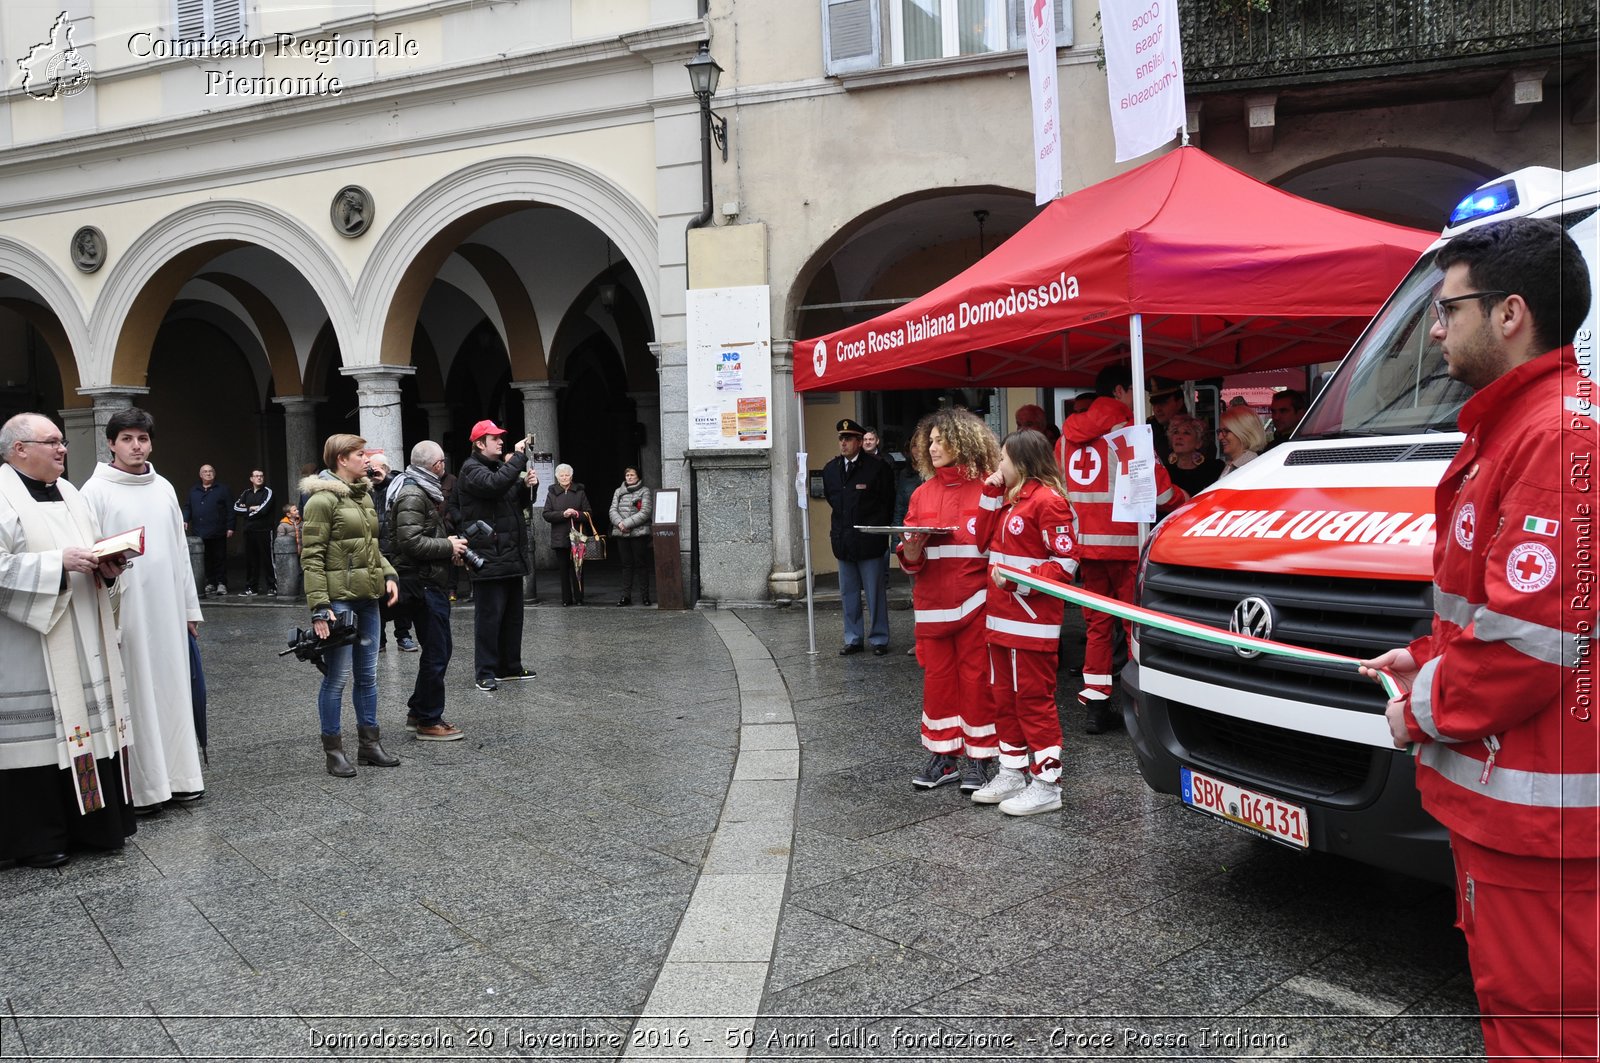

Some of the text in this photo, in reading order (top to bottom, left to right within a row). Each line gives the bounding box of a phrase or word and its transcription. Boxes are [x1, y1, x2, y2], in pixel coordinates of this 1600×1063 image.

[836, 271, 1080, 363] Croce Rossa Italiana Domodossola
[722, 352, 740, 362] NO
[1193, 776, 1303, 841] SBK 06131
